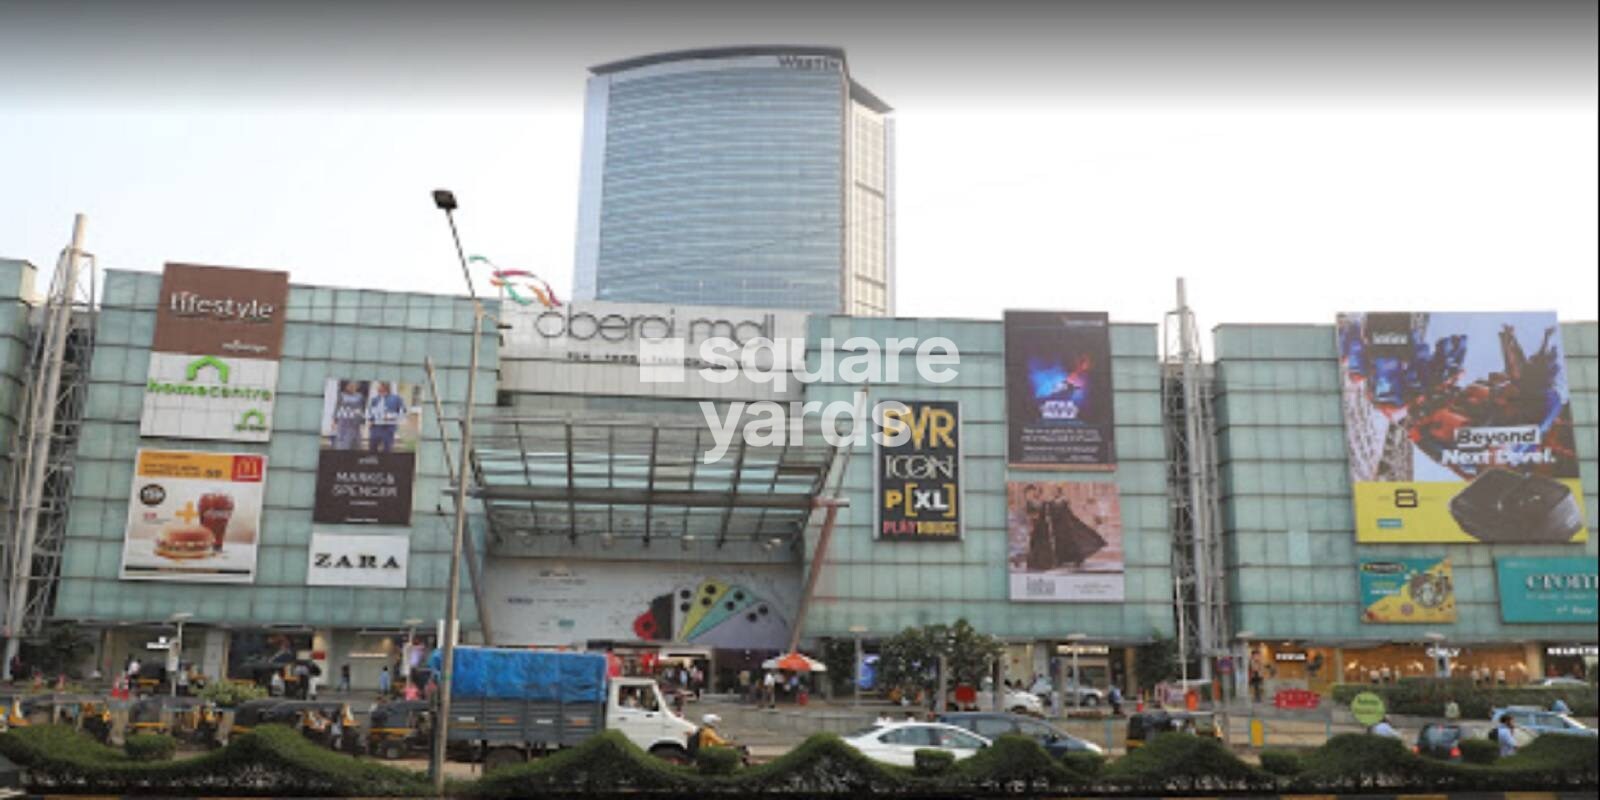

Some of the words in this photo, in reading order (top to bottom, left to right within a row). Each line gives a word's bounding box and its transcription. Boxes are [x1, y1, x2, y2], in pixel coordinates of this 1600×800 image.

[171, 292, 273, 320] lifestyle
[536, 303, 674, 342] oberoi
[882, 405, 956, 449] PVR
[1456, 429, 1536, 445] Beyond
[885, 454, 954, 479] ICON
[1441, 449, 1493, 465] Next
[332, 484, 398, 497] SPENCER
[314, 553, 400, 568] ZARA
